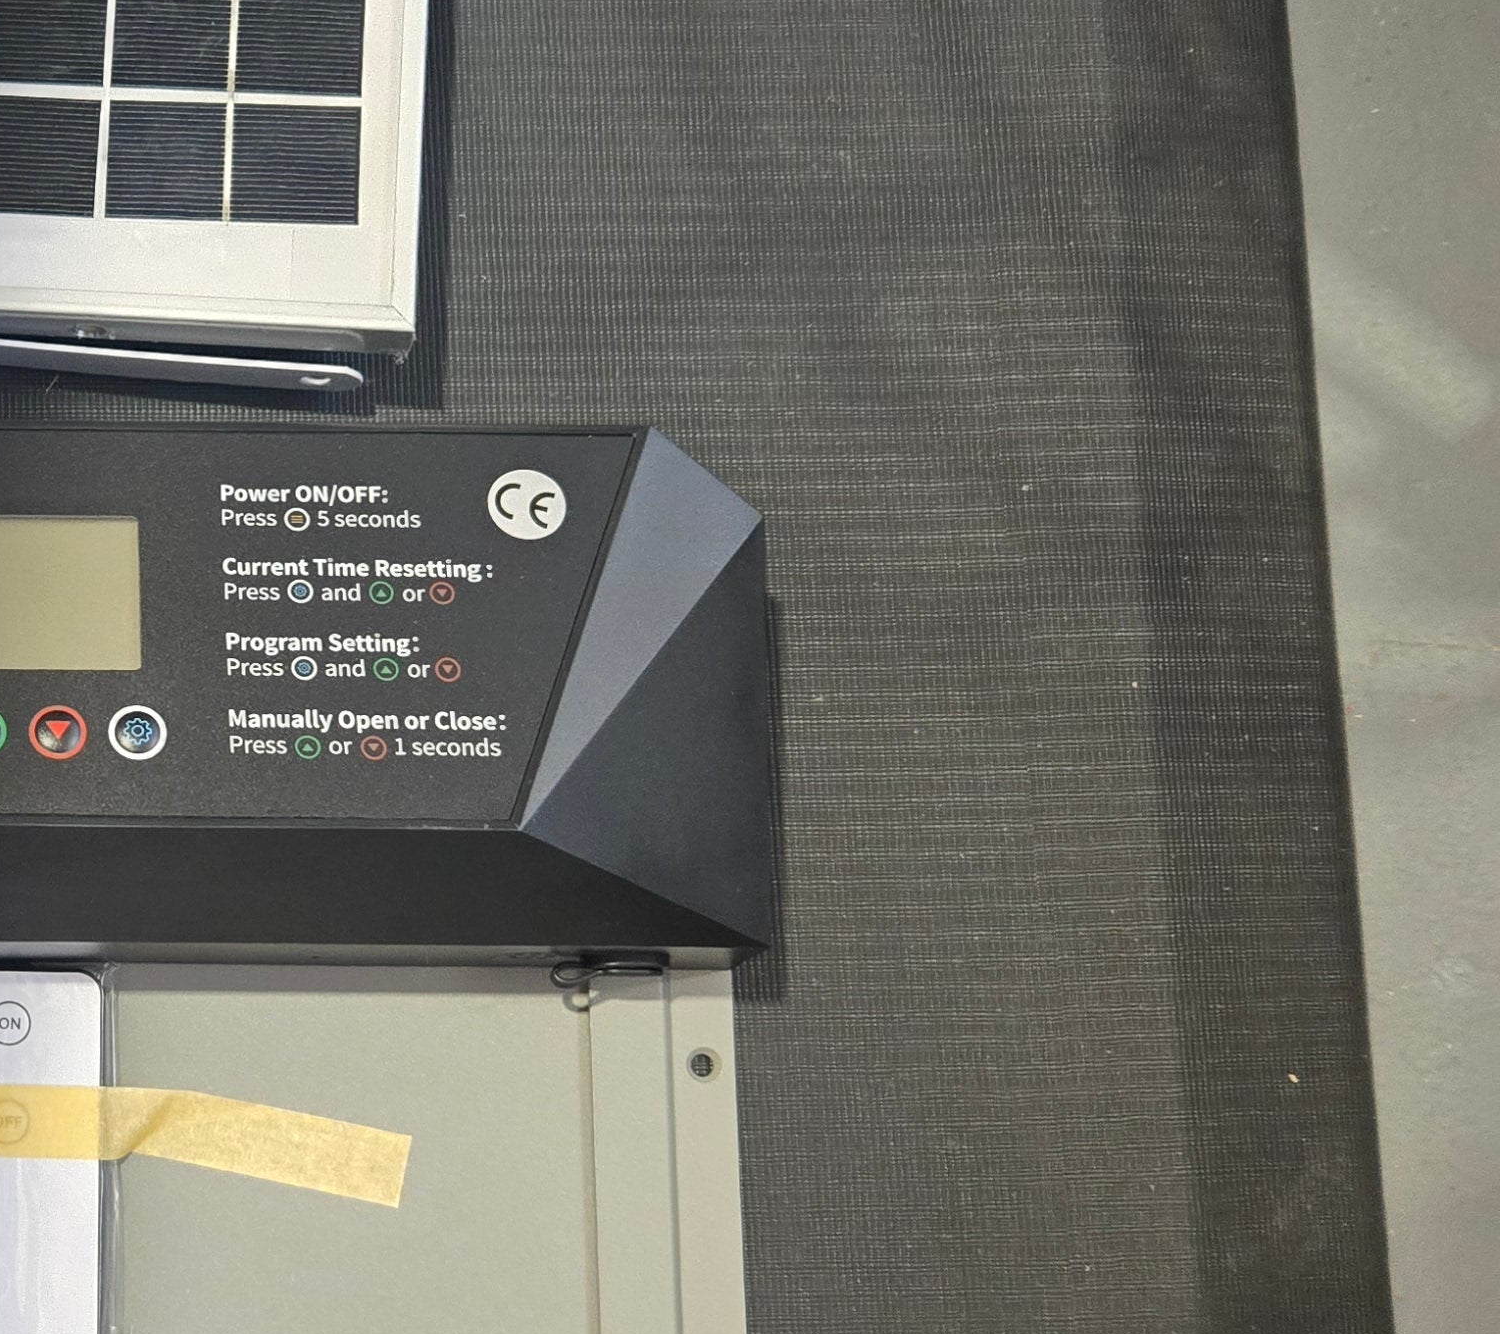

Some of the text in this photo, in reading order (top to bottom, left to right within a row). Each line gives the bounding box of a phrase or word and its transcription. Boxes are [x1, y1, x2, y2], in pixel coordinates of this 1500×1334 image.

[220, 483, 389, 506] Power ON/OFF:
[492, 482, 556, 531] CE
[221, 508, 422, 529] Press 5 seconds
[222, 557, 310, 577] Current
[312, 557, 370, 578] Time
[223, 582, 426, 603] Press and or
[225, 632, 420, 658] Program Setting:
[226, 657, 431, 679] Press and or
[228, 708, 507, 734] Manually Open or Close:
[229, 735, 502, 757] Press or 1 seconds
